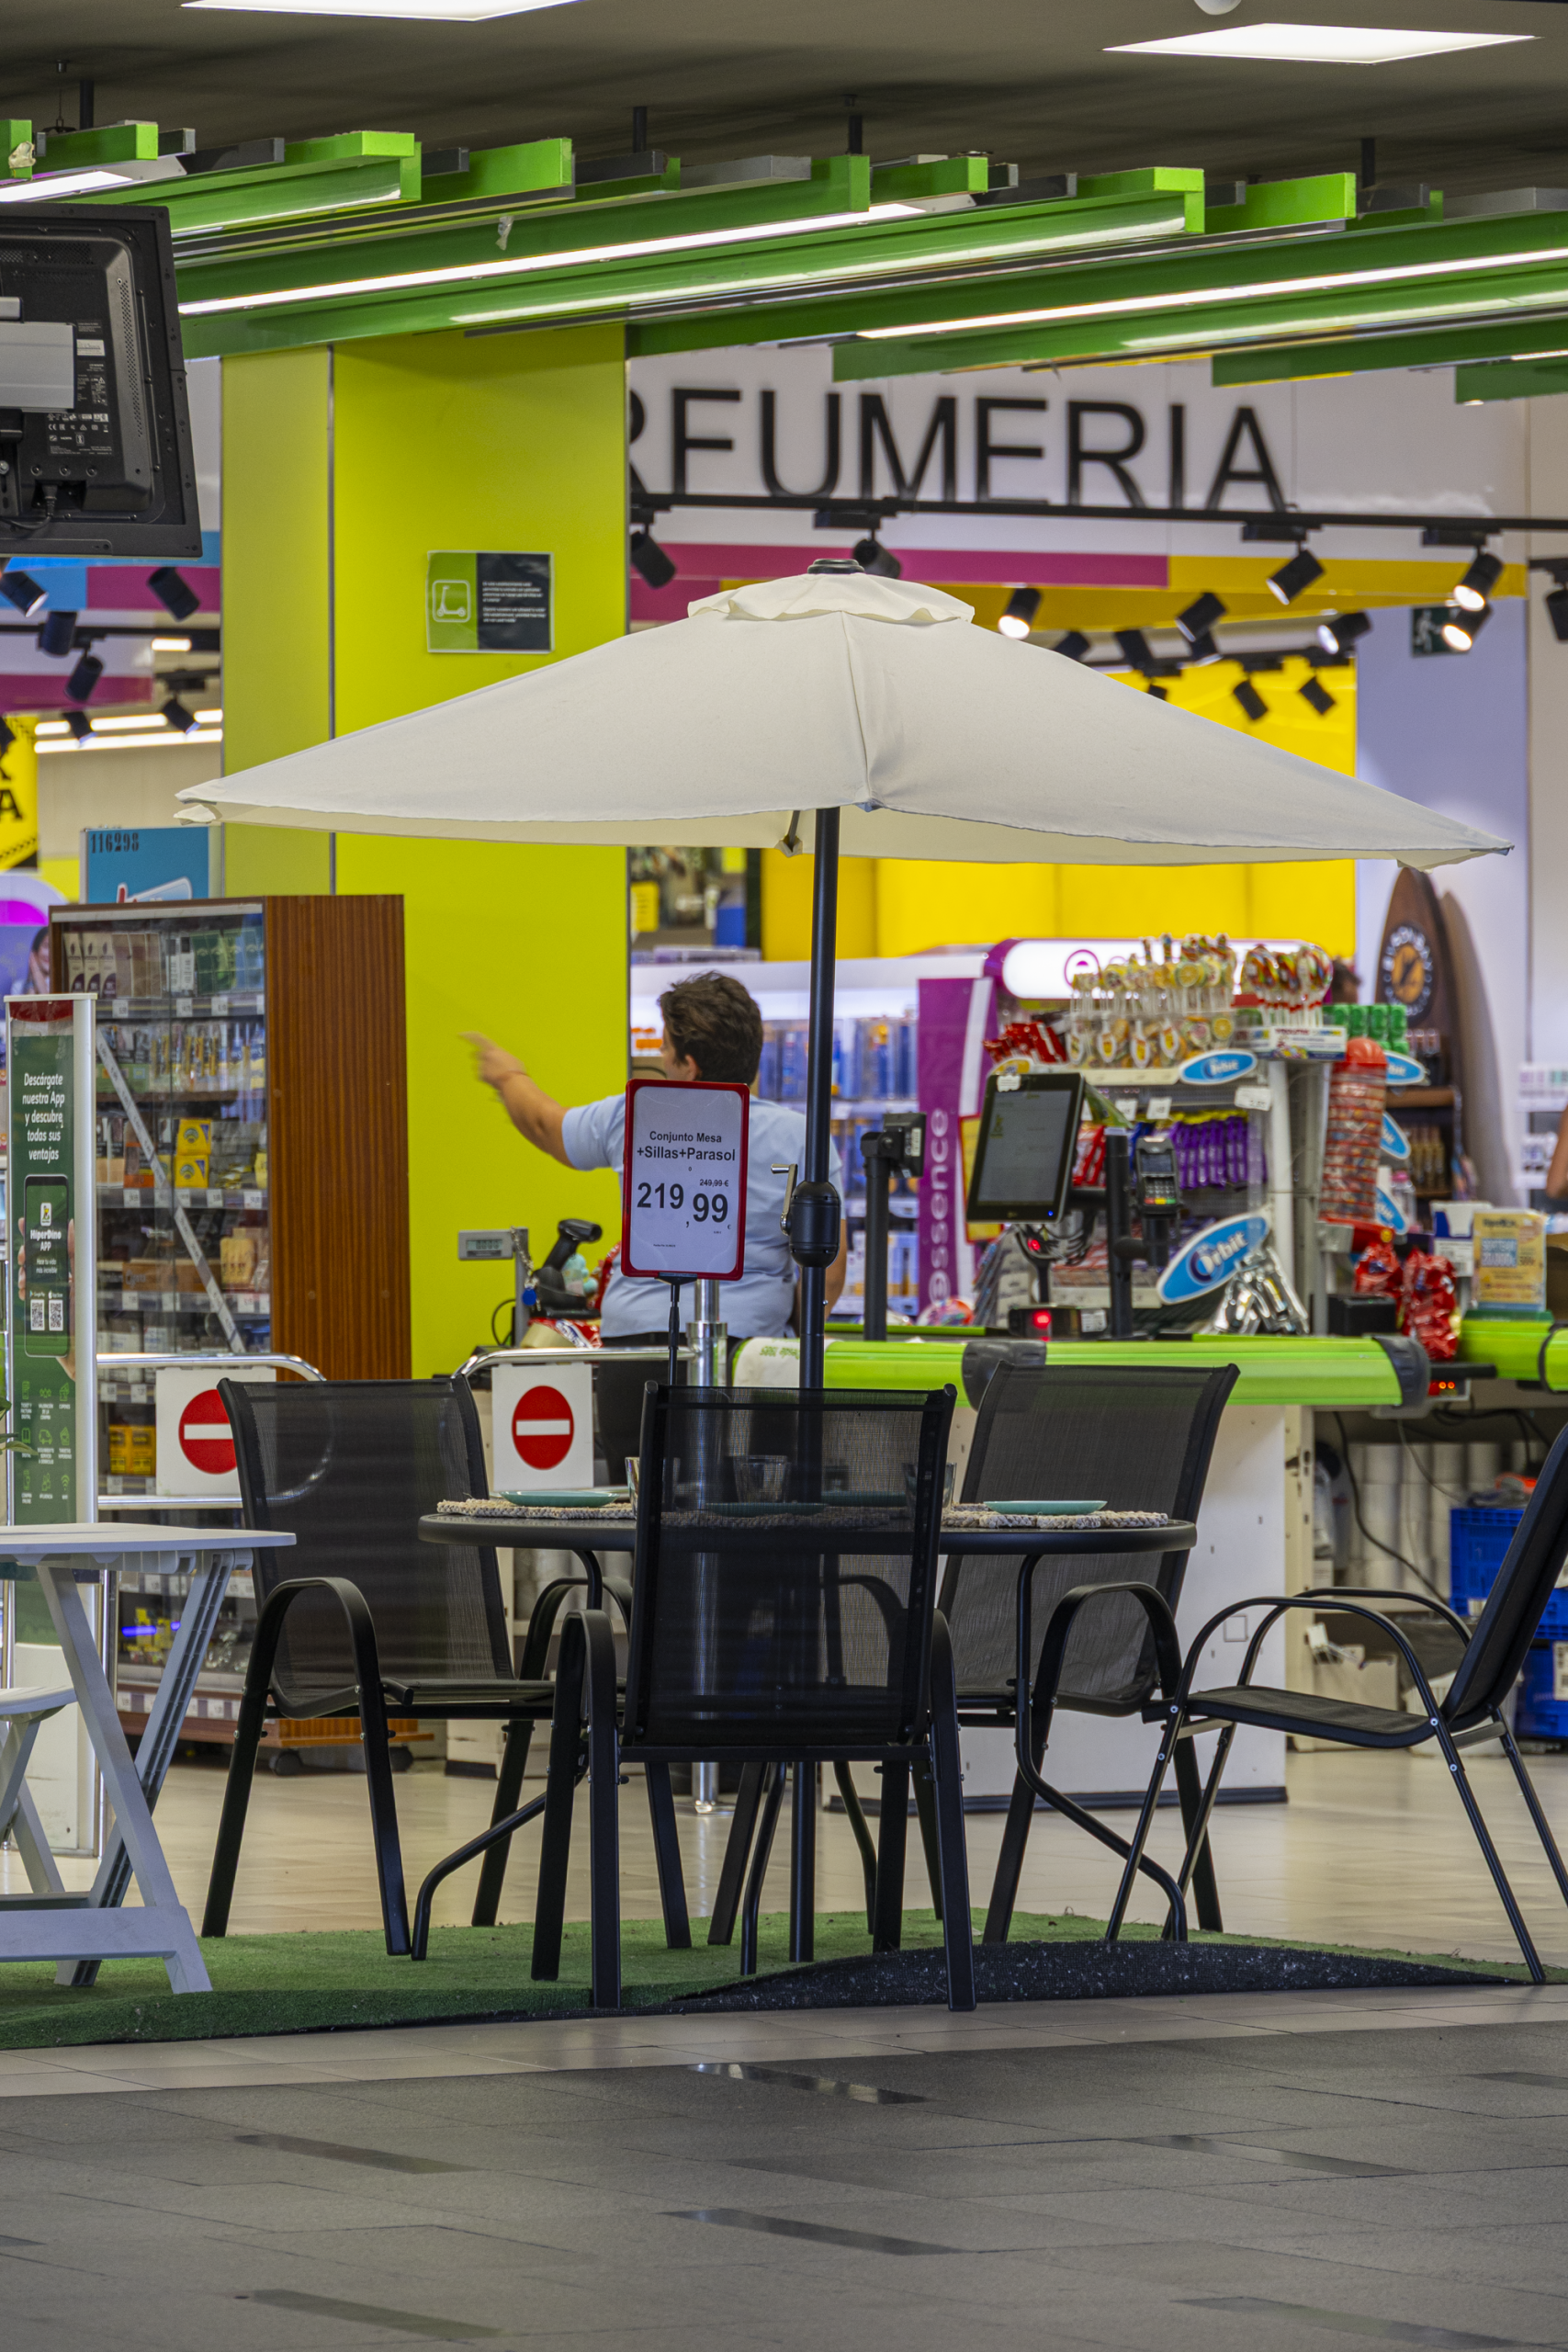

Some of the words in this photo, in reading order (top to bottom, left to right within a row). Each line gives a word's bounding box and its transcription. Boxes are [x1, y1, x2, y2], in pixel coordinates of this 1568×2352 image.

[629, 387, 1284, 512] FUMERIA
[91, 832, 139, 854] 116298
[24, 1072, 62, 1090] Descárgate
[22, 1093, 49, 1104] nuestra
[50, 1091, 64, 1108] App
[25, 1113, 29, 1126] y
[31, 1110, 62, 1123] descubre
[28, 1128, 47, 1141] todas
[48, 1131, 61, 1141] sus
[649, 1131, 694, 1143] Conjunto
[696, 1133, 722, 1143] Mesa
[28, 1147, 59, 1164] ventajas
[637, 1146, 736, 1161] +Sillas+Parasol
[30, 1230, 62, 1241] HiperDino
[40, 1241, 51, 1251] APP
